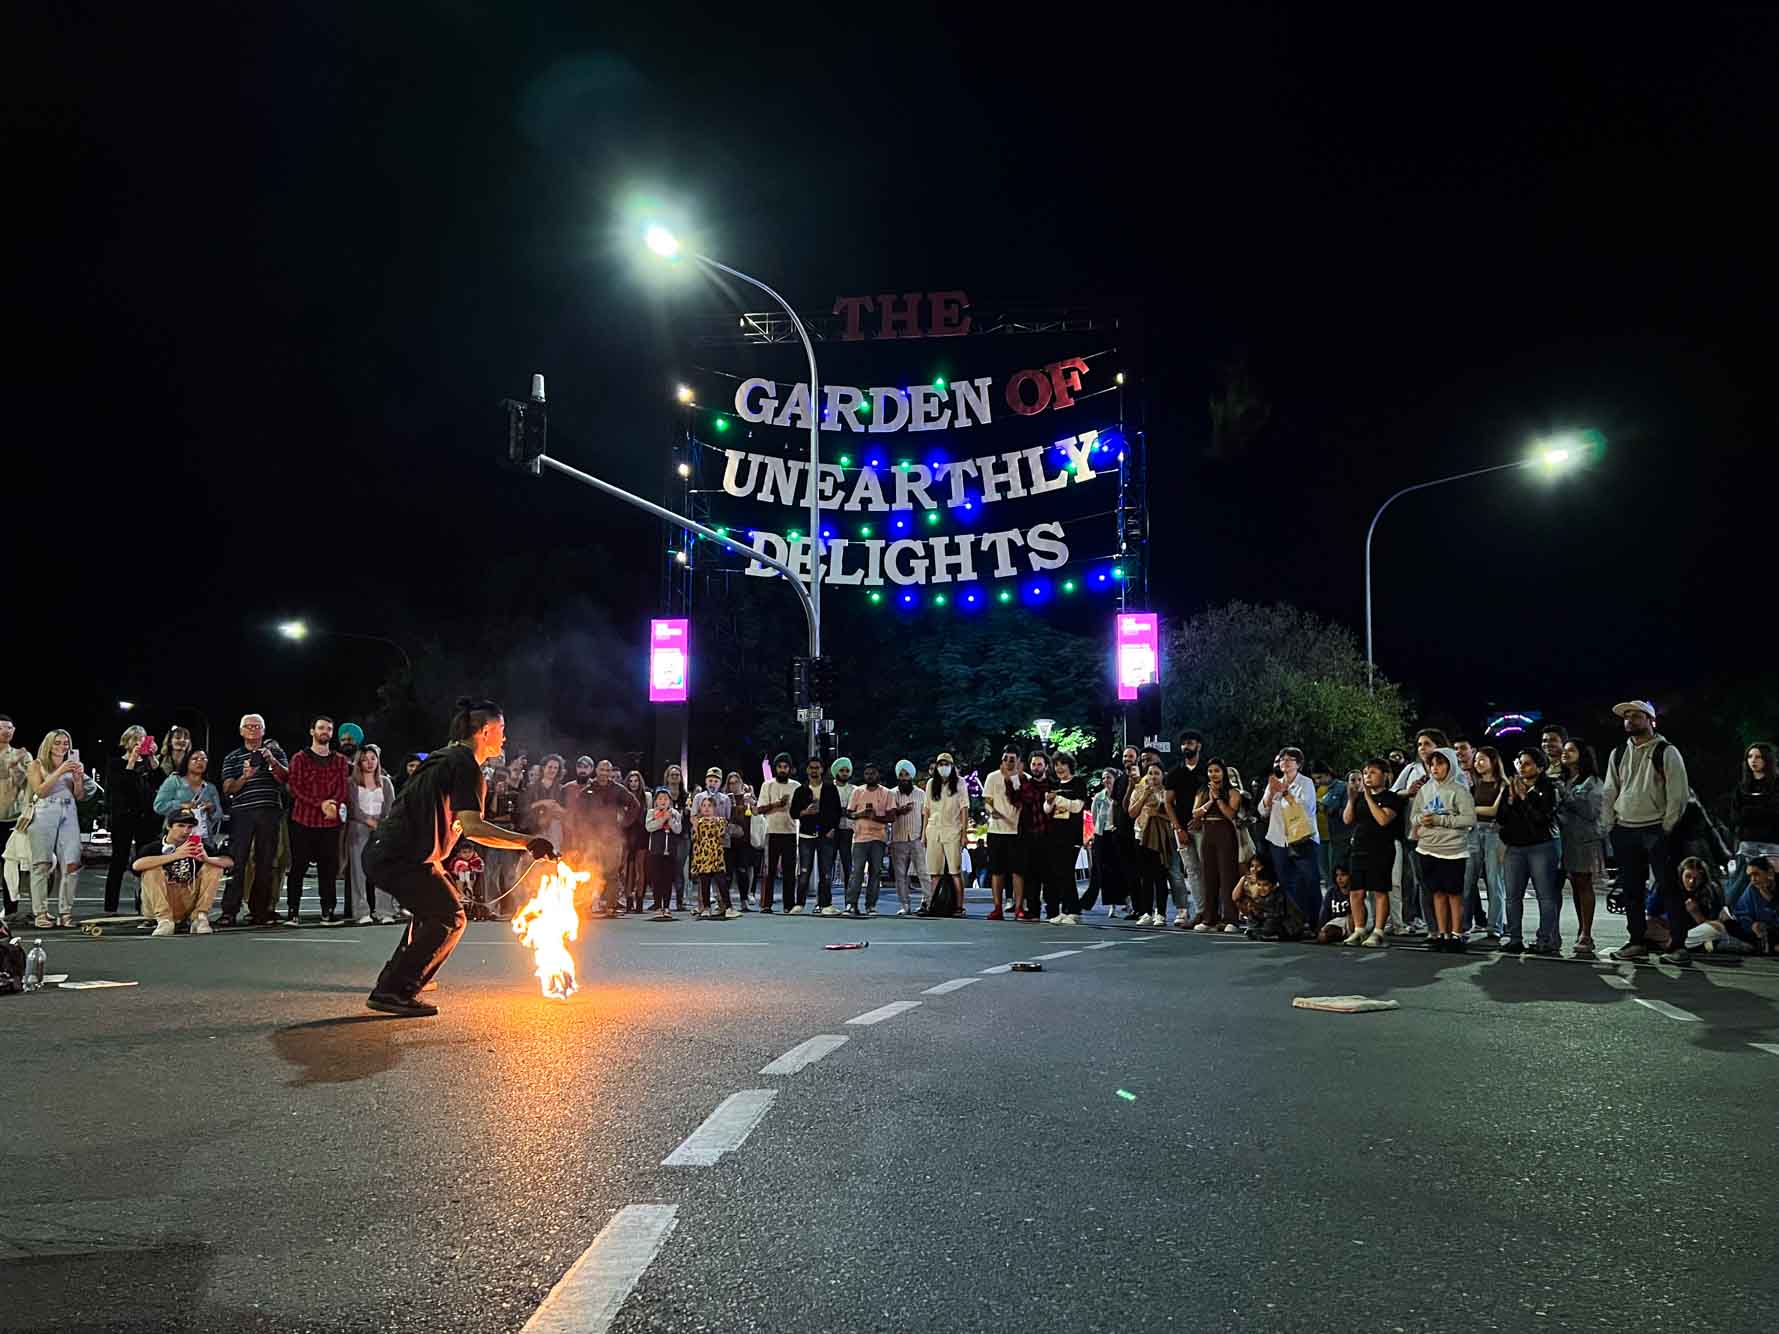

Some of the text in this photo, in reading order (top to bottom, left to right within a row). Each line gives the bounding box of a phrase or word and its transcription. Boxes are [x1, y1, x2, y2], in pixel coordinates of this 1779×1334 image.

[833, 291, 973, 342] THE
[734, 356, 1091, 433] GARDEN OF
[722, 430, 1100, 512] UNEARTHLY
[744, 521, 1070, 586] DELIGHTS
